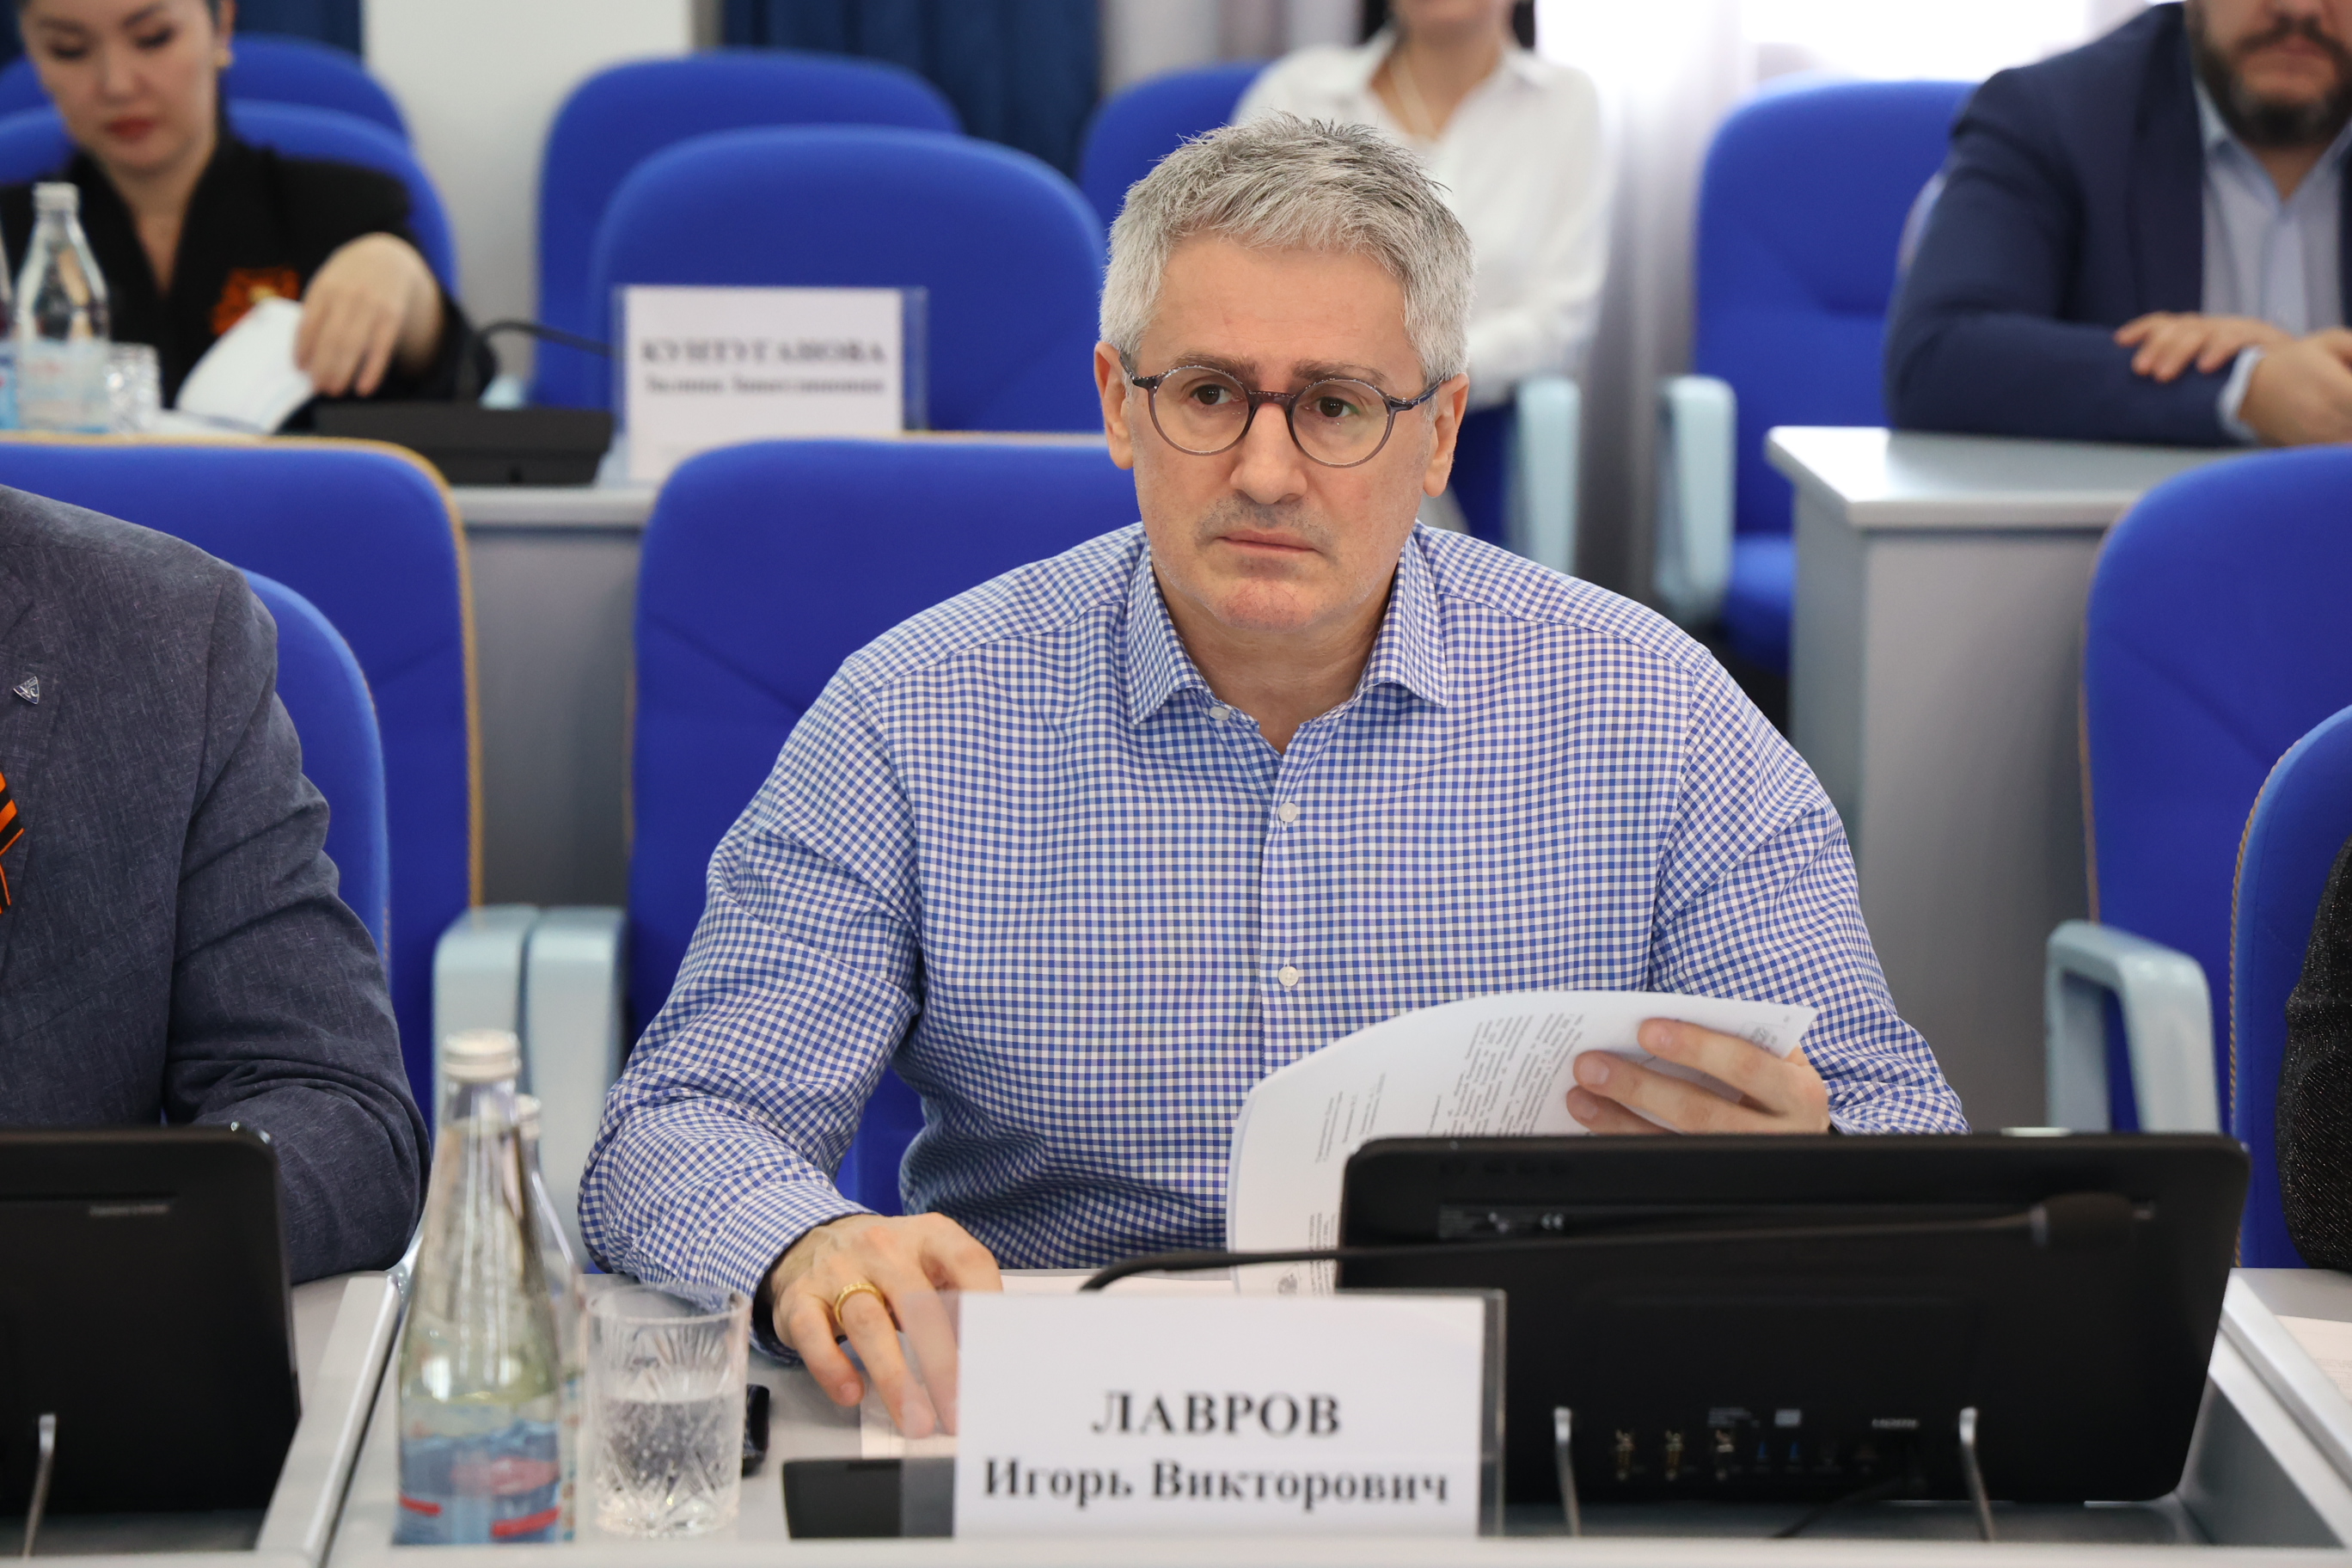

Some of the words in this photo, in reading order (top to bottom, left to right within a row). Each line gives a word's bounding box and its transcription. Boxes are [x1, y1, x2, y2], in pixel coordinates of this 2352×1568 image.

[1091, 1389, 1341, 1436] ЛАВРОВ
[984, 1457, 1134, 1509] Игорь
[1151, 1459, 1449, 1511] Викторович
